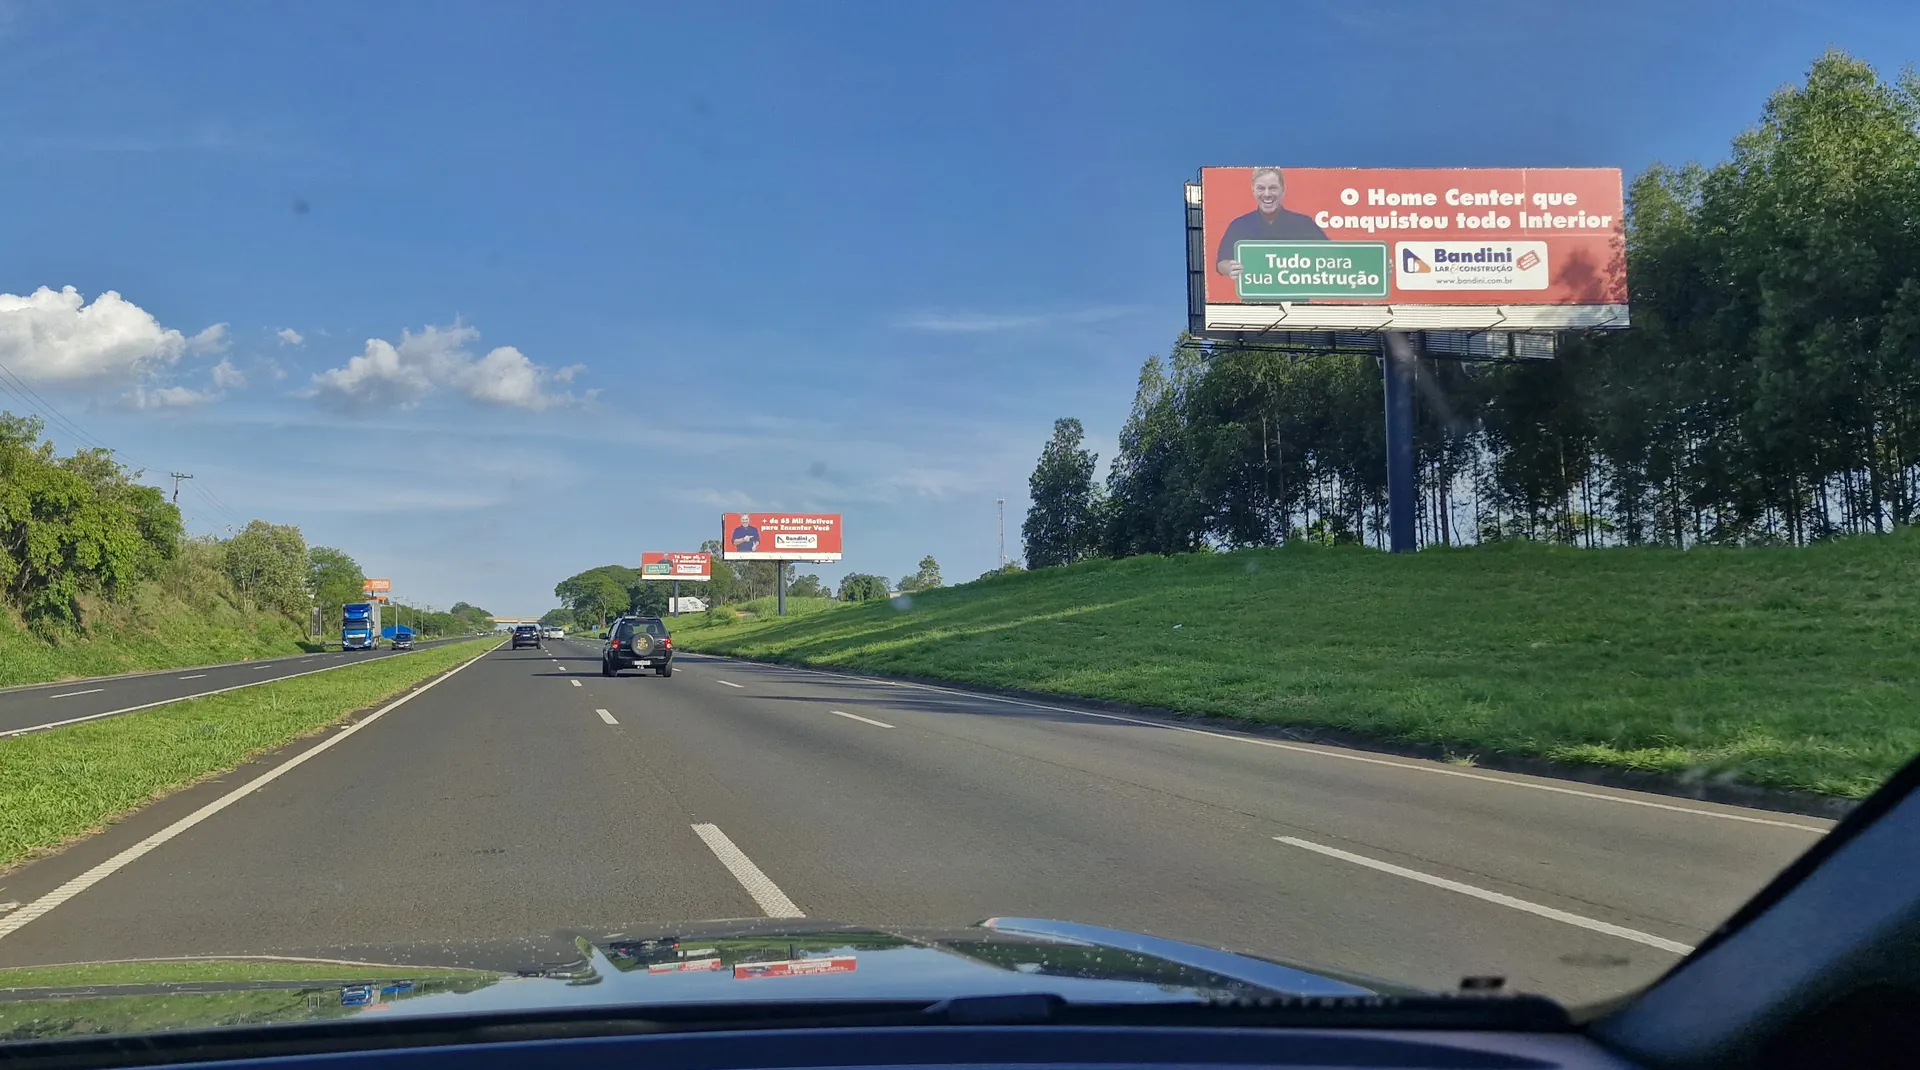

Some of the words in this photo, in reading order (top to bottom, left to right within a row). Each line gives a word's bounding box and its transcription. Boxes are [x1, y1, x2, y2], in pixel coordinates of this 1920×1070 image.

[1340, 188, 1360, 206] O
[1368, 188, 1437, 206] Home
[1445, 188, 1524, 206] Center
[1532, 192, 1578, 210] que
[1314, 211, 1449, 233] Conquistou
[1456, 211, 1511, 229] todo
[1519, 210, 1613, 229] Interior
[1265, 253, 1311, 269] Tudo
[1315, 257, 1352, 272] para
[1434, 247, 1513, 263] Bandini
[1244, 273, 1273, 285] sua
[1277, 270, 1380, 289] Construção
[1435, 277, 1513, 285] www.bandini.com.br
[791, 517, 804, 525] Mil
